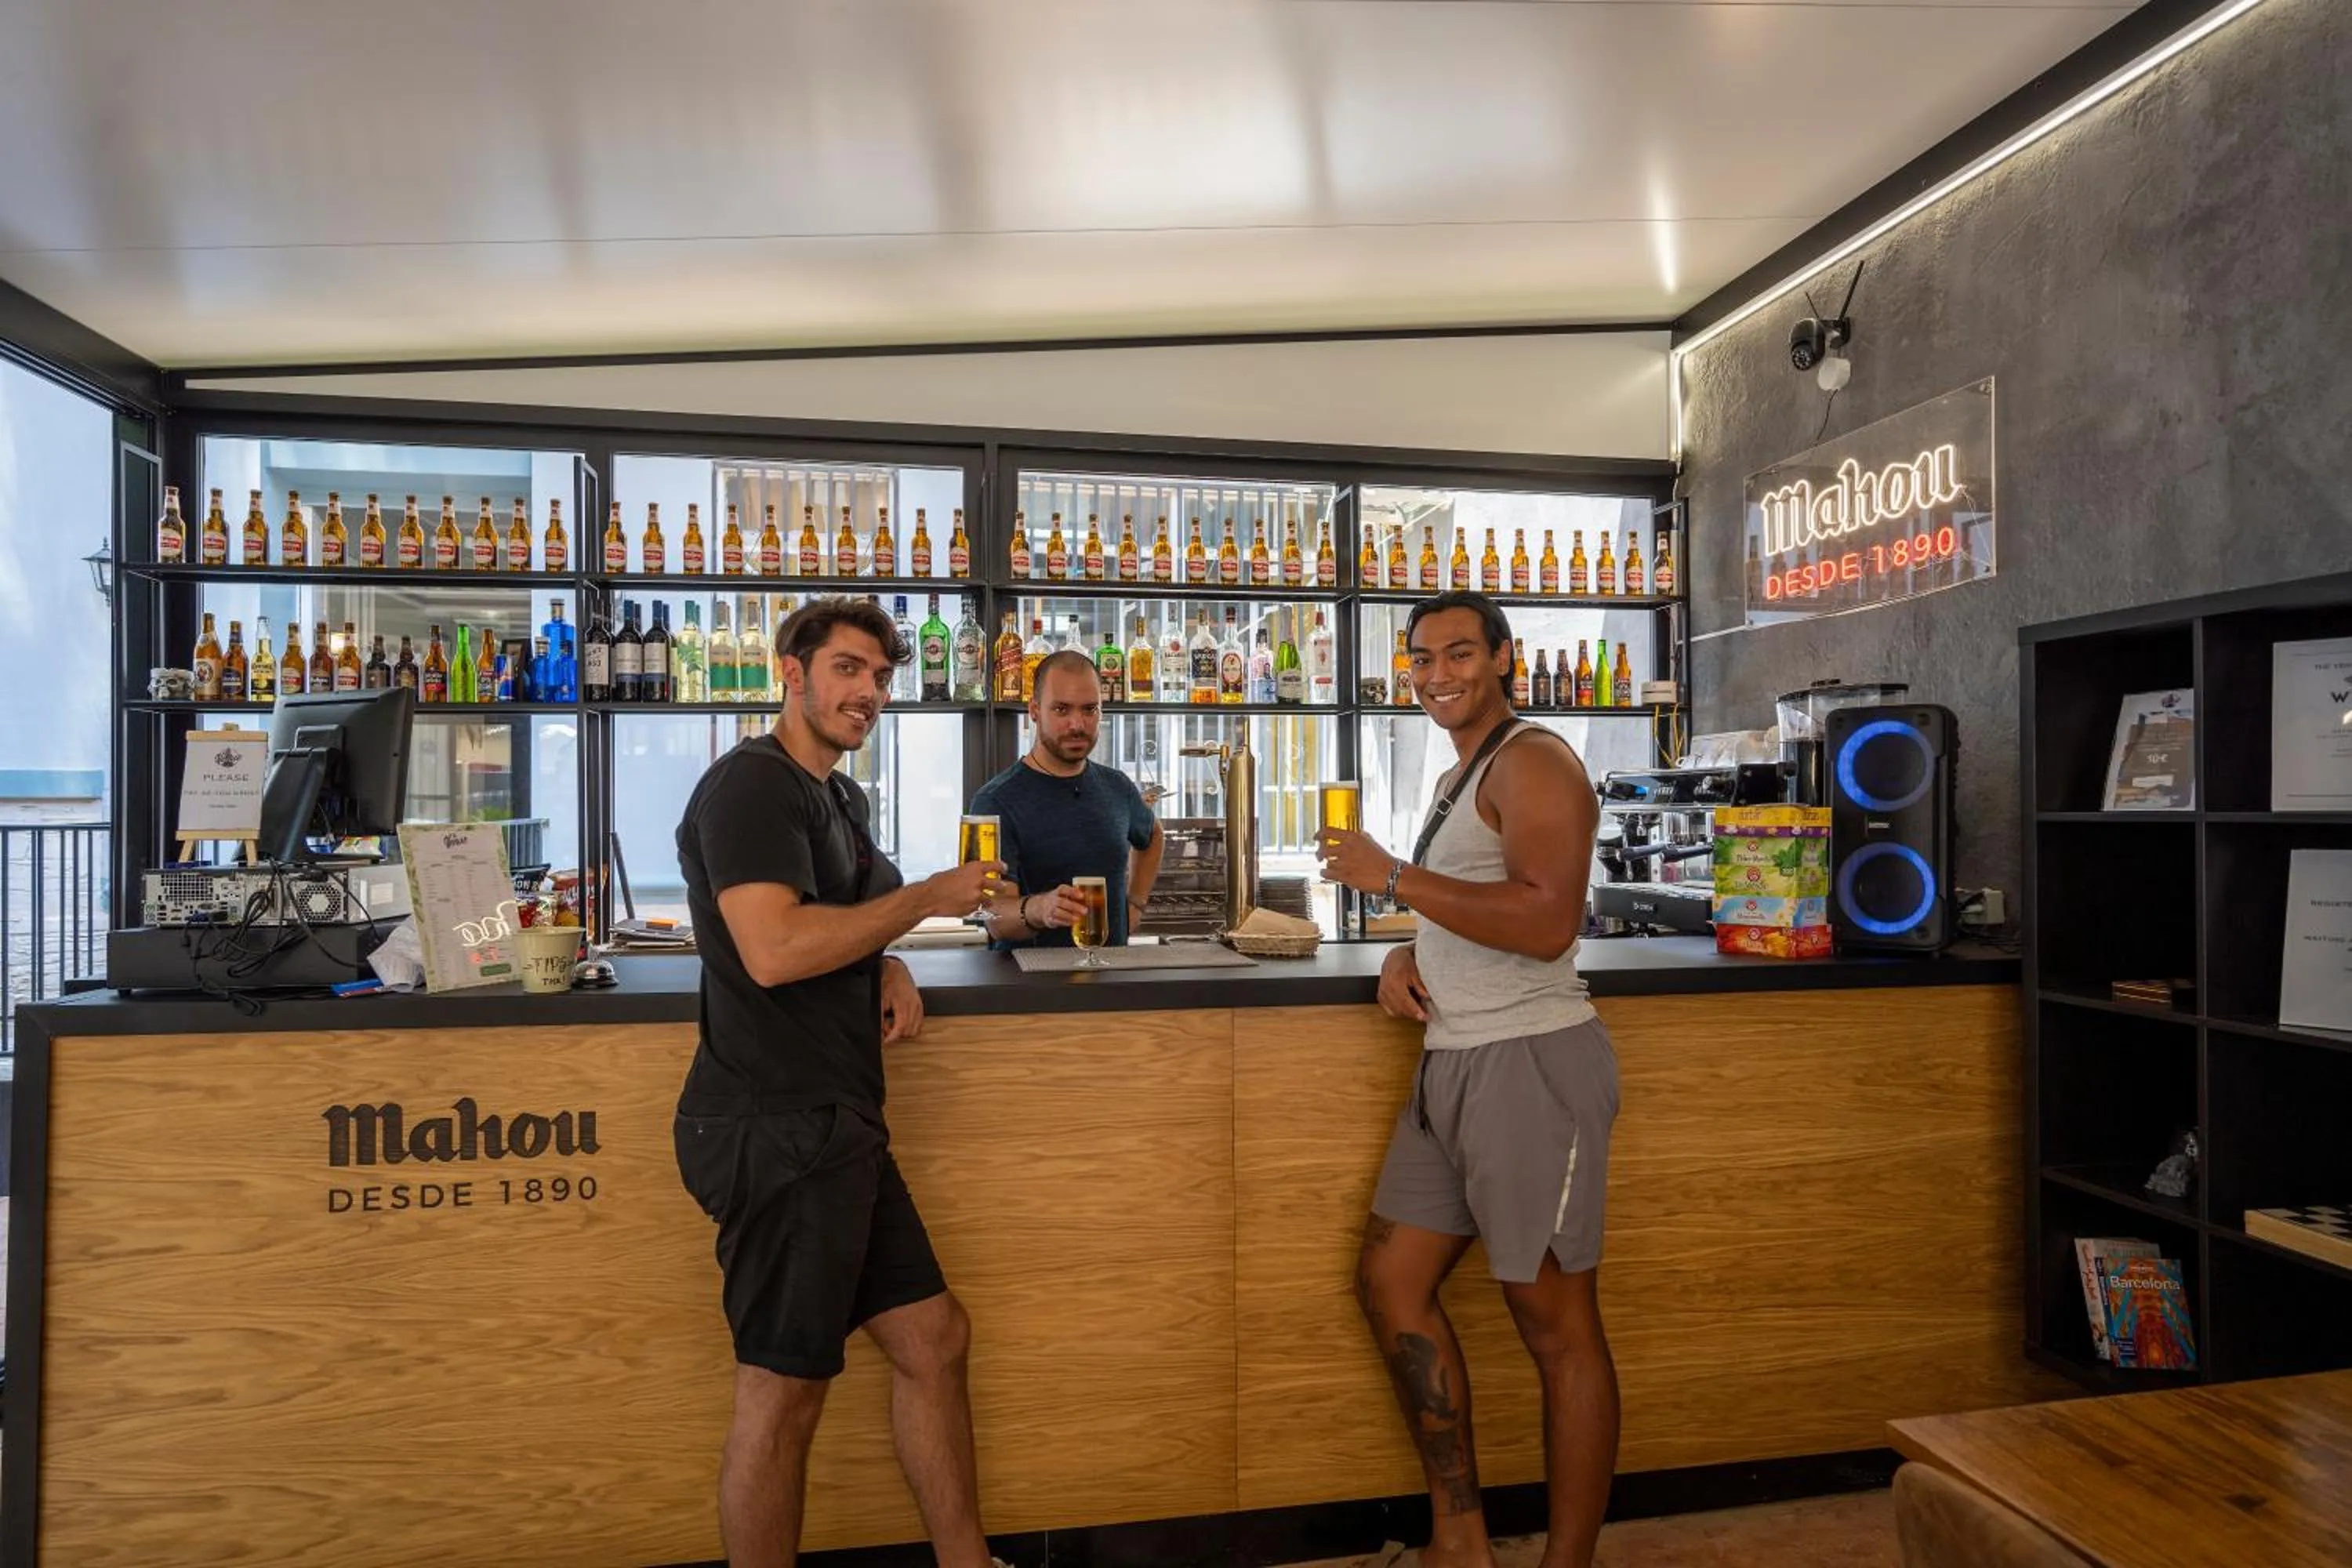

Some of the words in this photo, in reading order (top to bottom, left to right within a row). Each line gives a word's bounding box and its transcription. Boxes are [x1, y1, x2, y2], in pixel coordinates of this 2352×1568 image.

[1765, 553, 1860, 601] DESDE
[1873, 527, 1955, 574] 1890
[328, 1182, 474, 1214] DESDE
[499, 1176, 597, 1205] 1890
[2110, 1275, 2180, 1290] Barcelona
